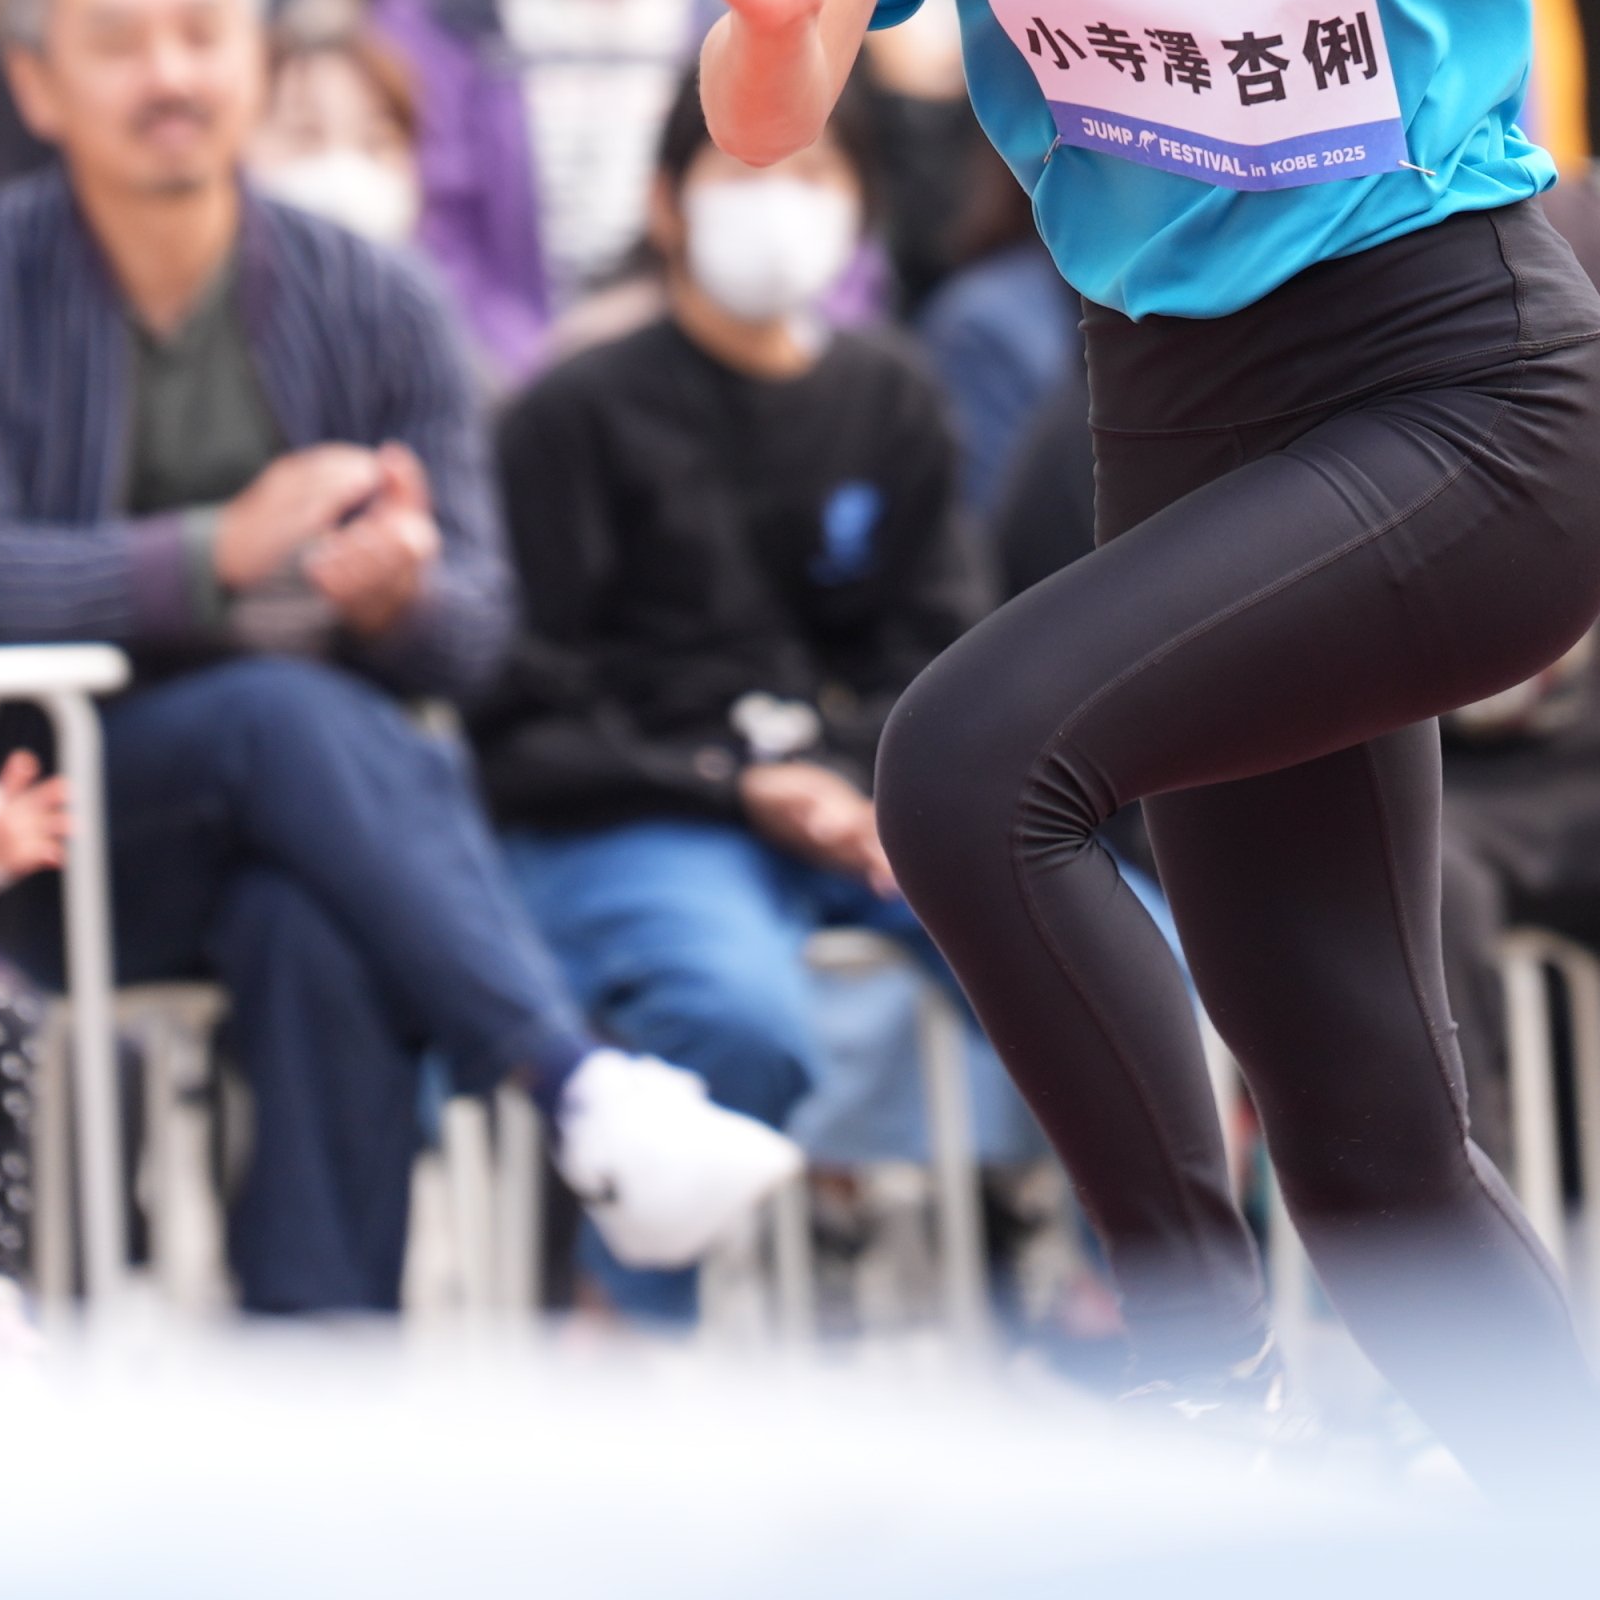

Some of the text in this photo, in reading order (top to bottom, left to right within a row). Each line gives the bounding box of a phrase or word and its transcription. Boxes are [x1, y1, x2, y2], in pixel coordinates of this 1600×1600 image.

[1081, 117, 1366, 177] JUMP FESTIVAL in KOBE 2025
